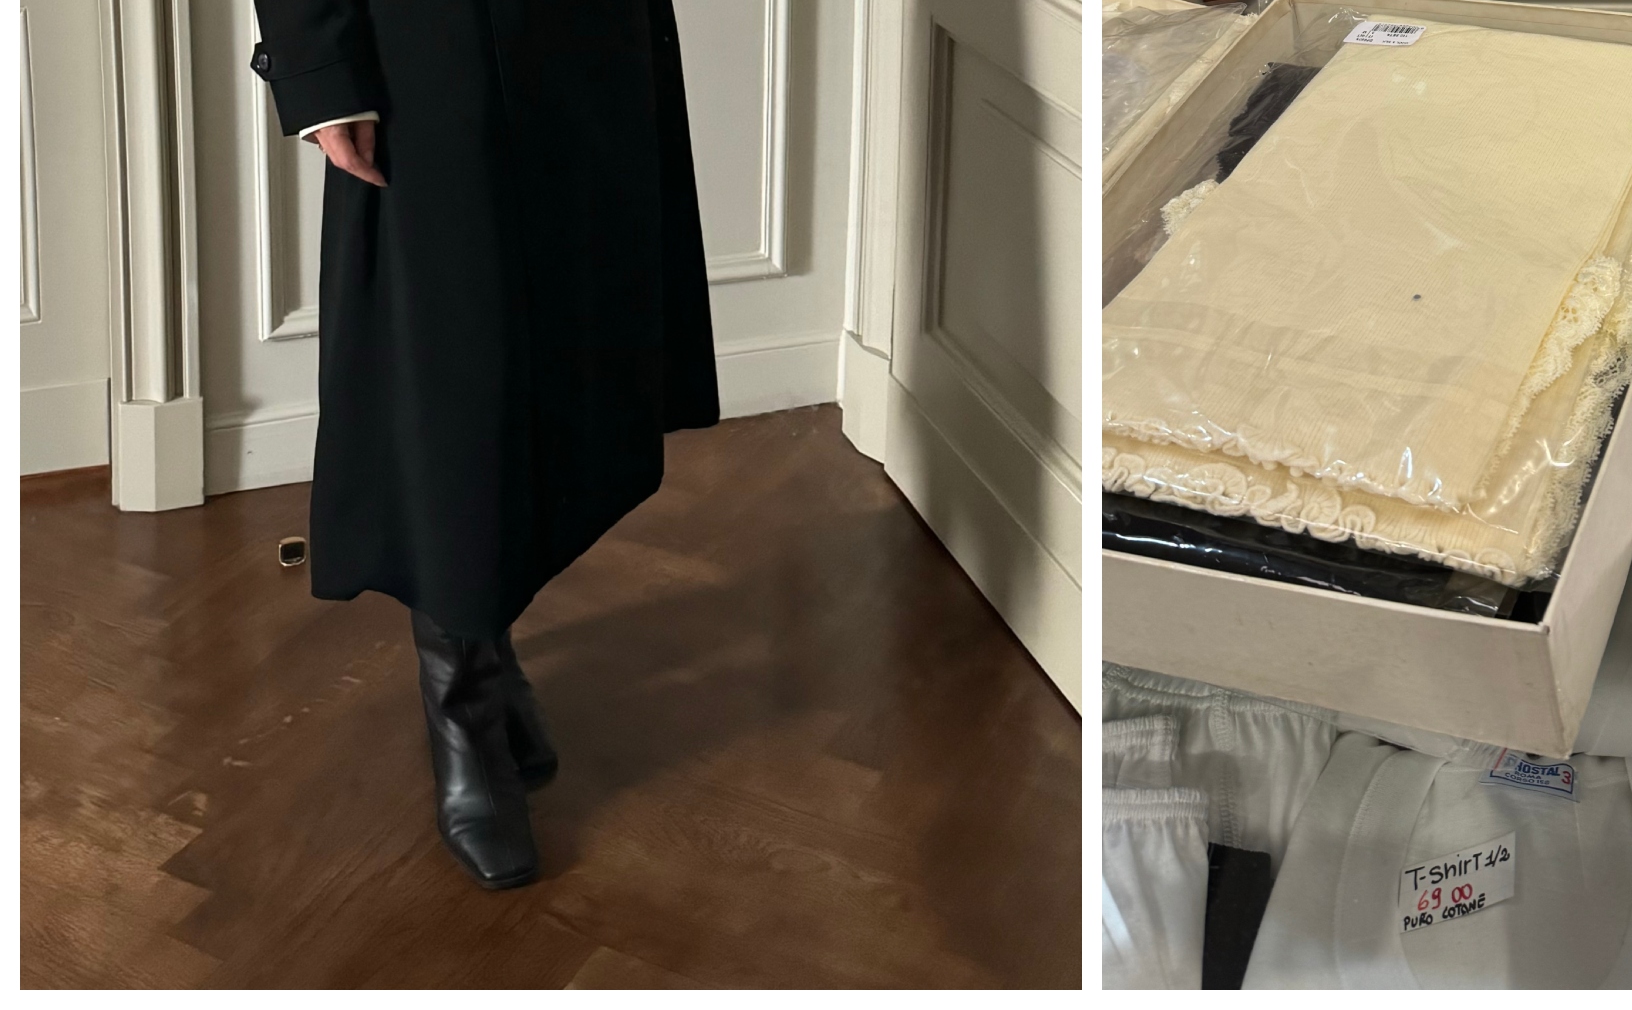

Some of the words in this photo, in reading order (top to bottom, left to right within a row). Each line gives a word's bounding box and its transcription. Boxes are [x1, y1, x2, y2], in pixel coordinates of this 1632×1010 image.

[1504, 772, 1536, 784] CORSO
[1514, 770, 1542, 780] ROMA
[1561, 770, 1572, 785] 3
[1484, 844, 1510, 868] 1/2
[1403, 911, 1433, 931] PURO
